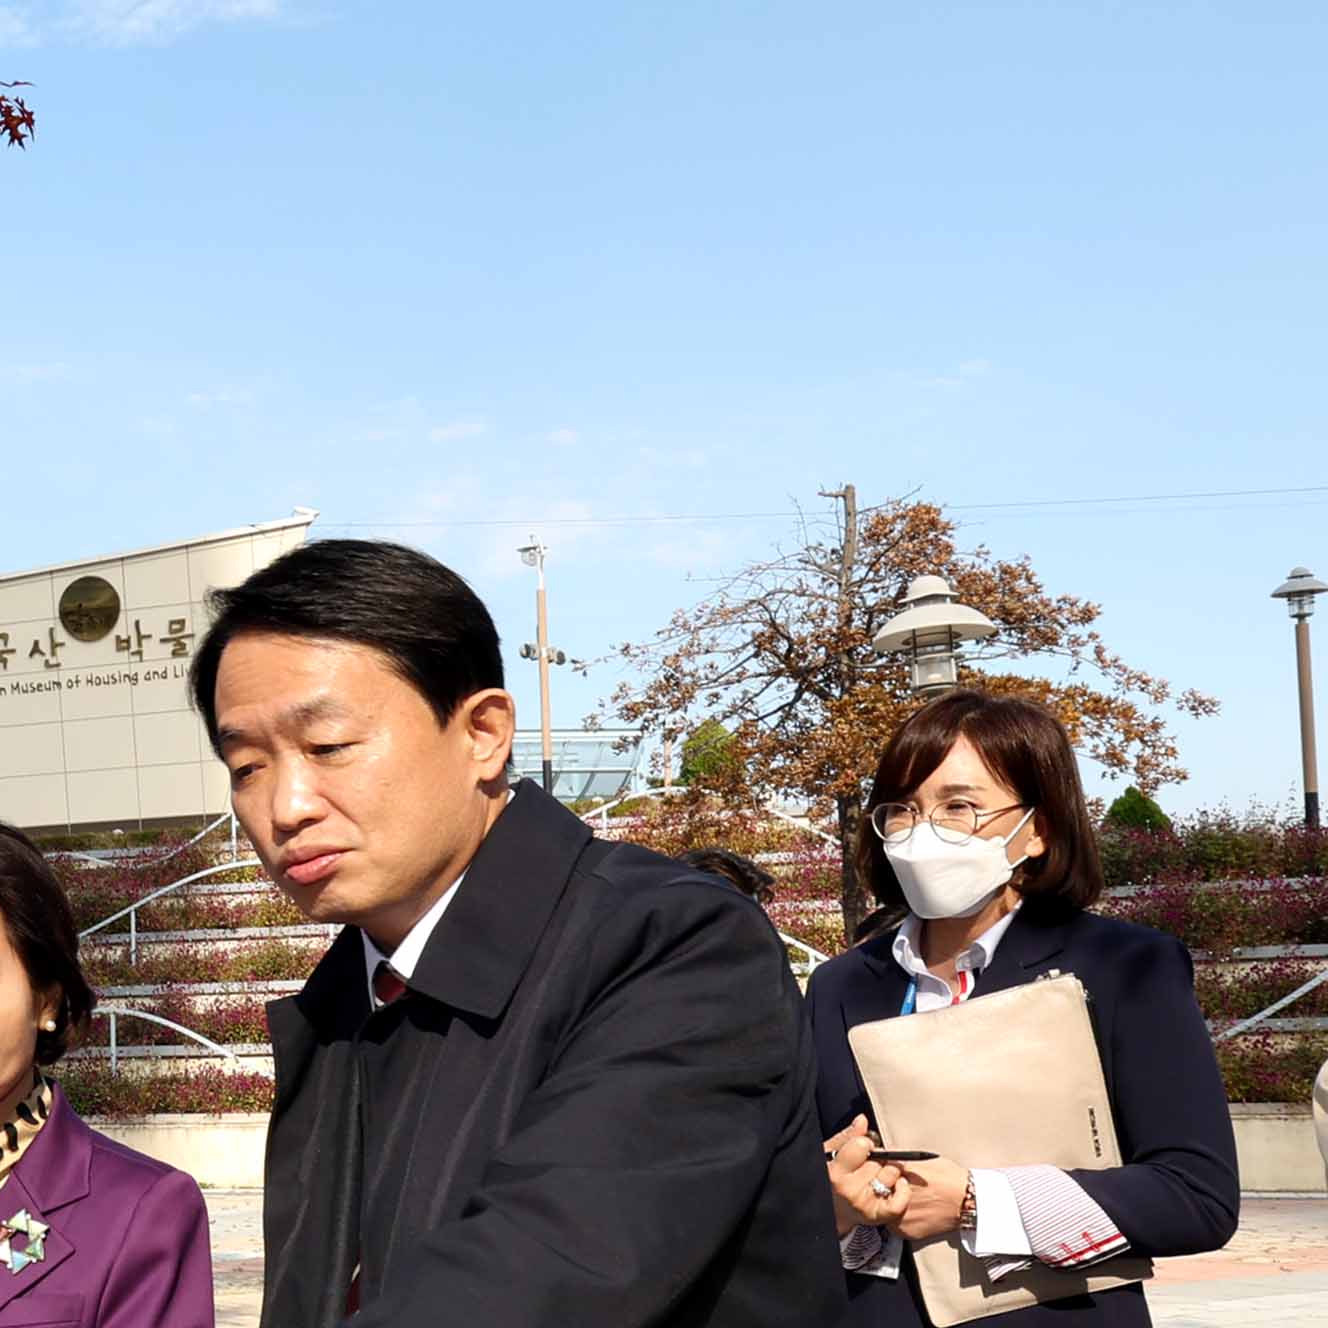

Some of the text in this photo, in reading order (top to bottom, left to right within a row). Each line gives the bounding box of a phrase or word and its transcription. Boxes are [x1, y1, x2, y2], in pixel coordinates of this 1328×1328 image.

[10, 679, 62, 695] Museum
[66, 676, 82, 689] of
[86, 668, 139, 687] Housing
[143, 667, 168, 682] and
